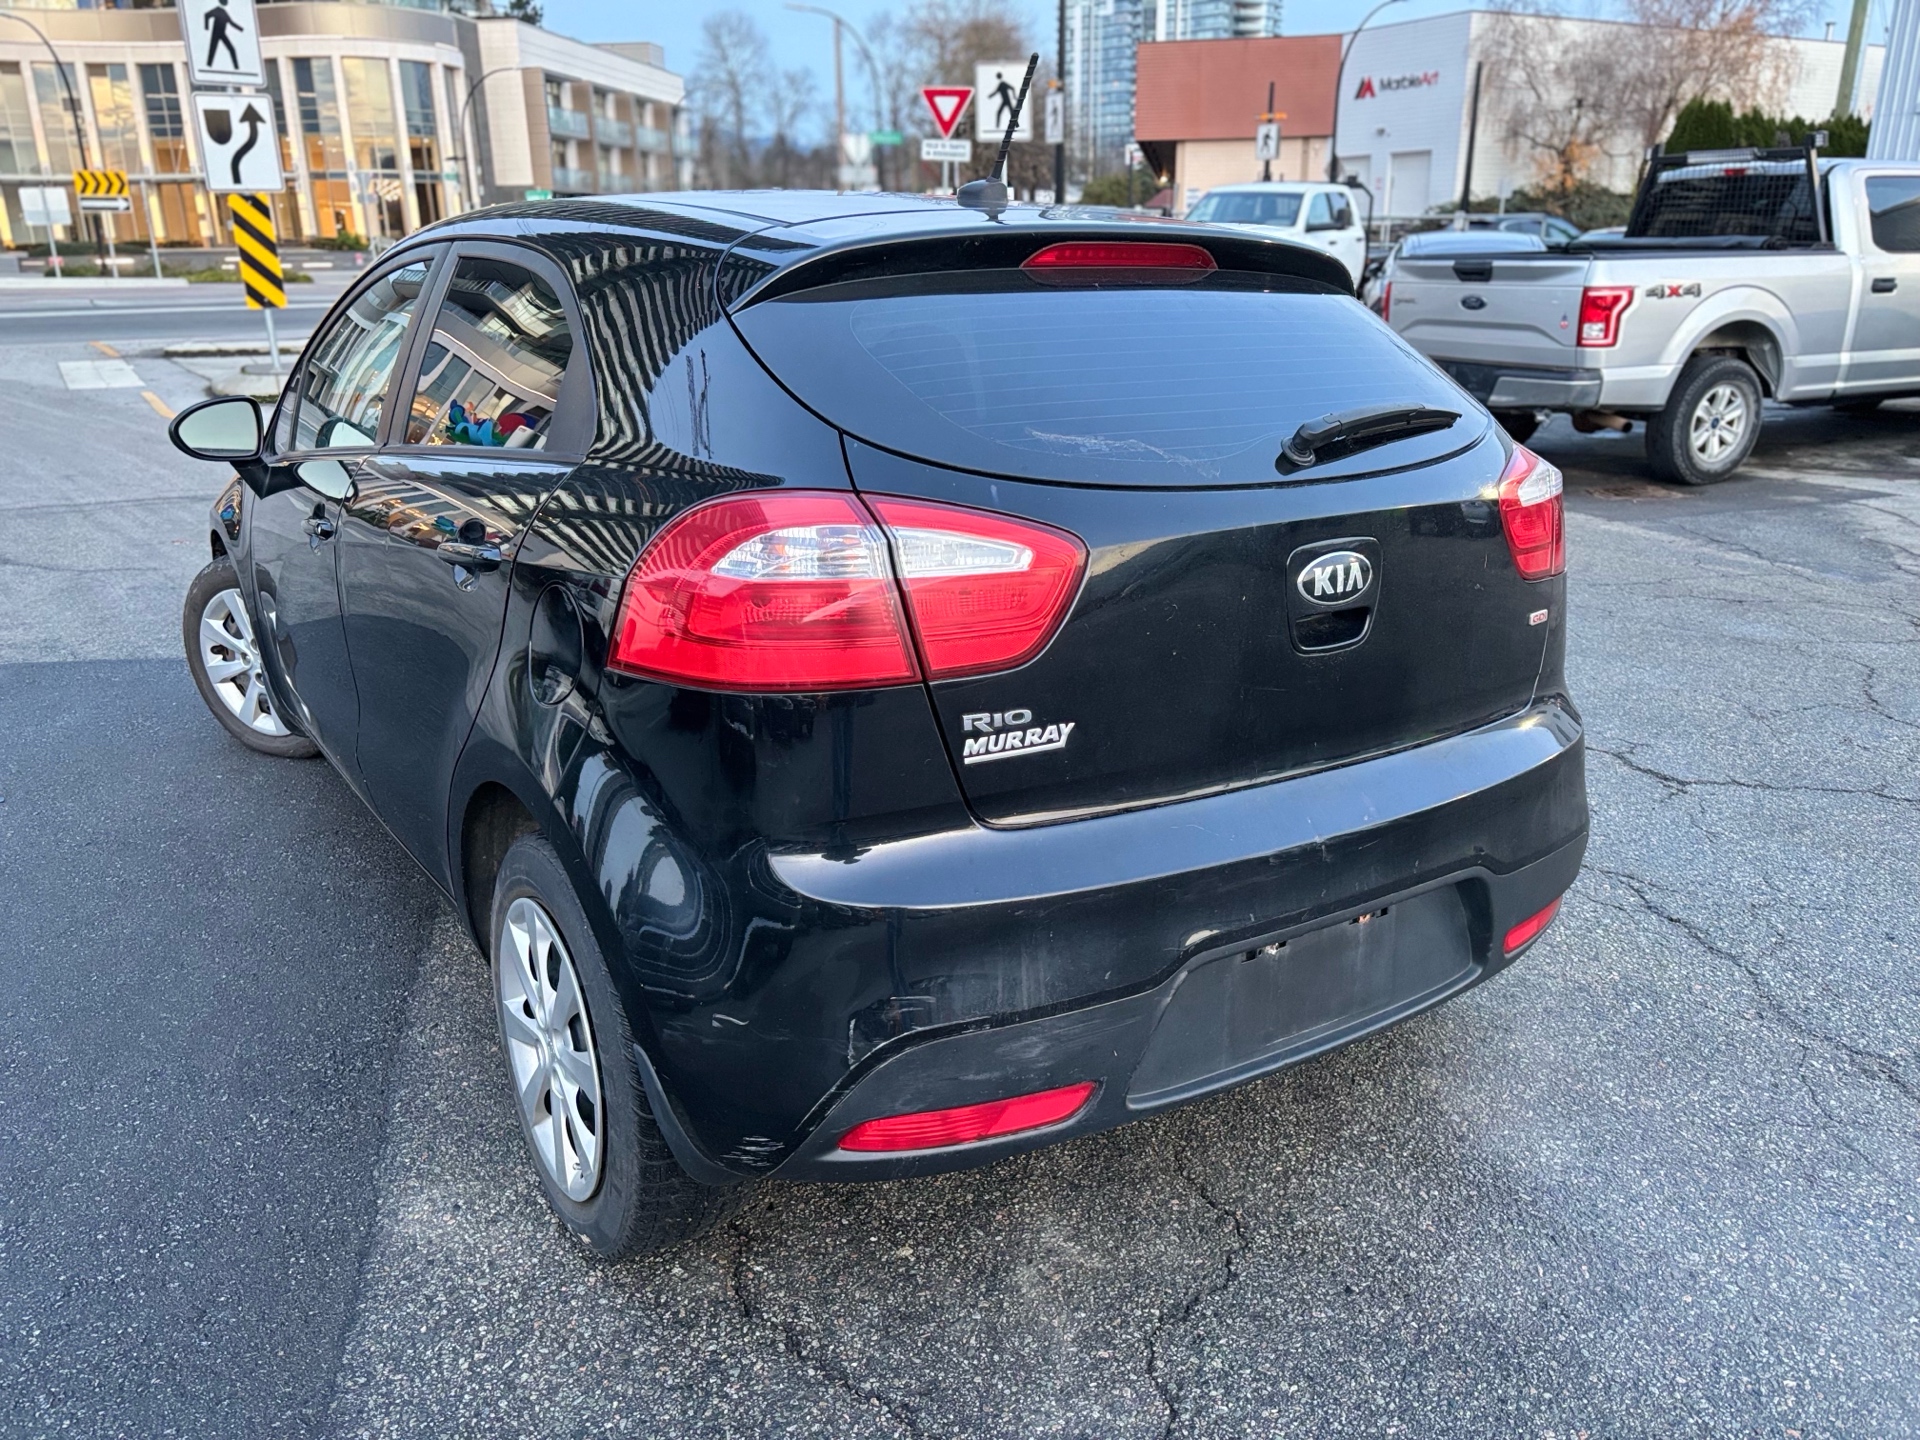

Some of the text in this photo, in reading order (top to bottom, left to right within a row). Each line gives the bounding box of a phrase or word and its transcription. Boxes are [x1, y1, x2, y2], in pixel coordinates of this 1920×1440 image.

[1313, 562, 1364, 596] KIA
[962, 709, 1032, 732] RIO
[963, 722, 1075, 757] MURRAY
